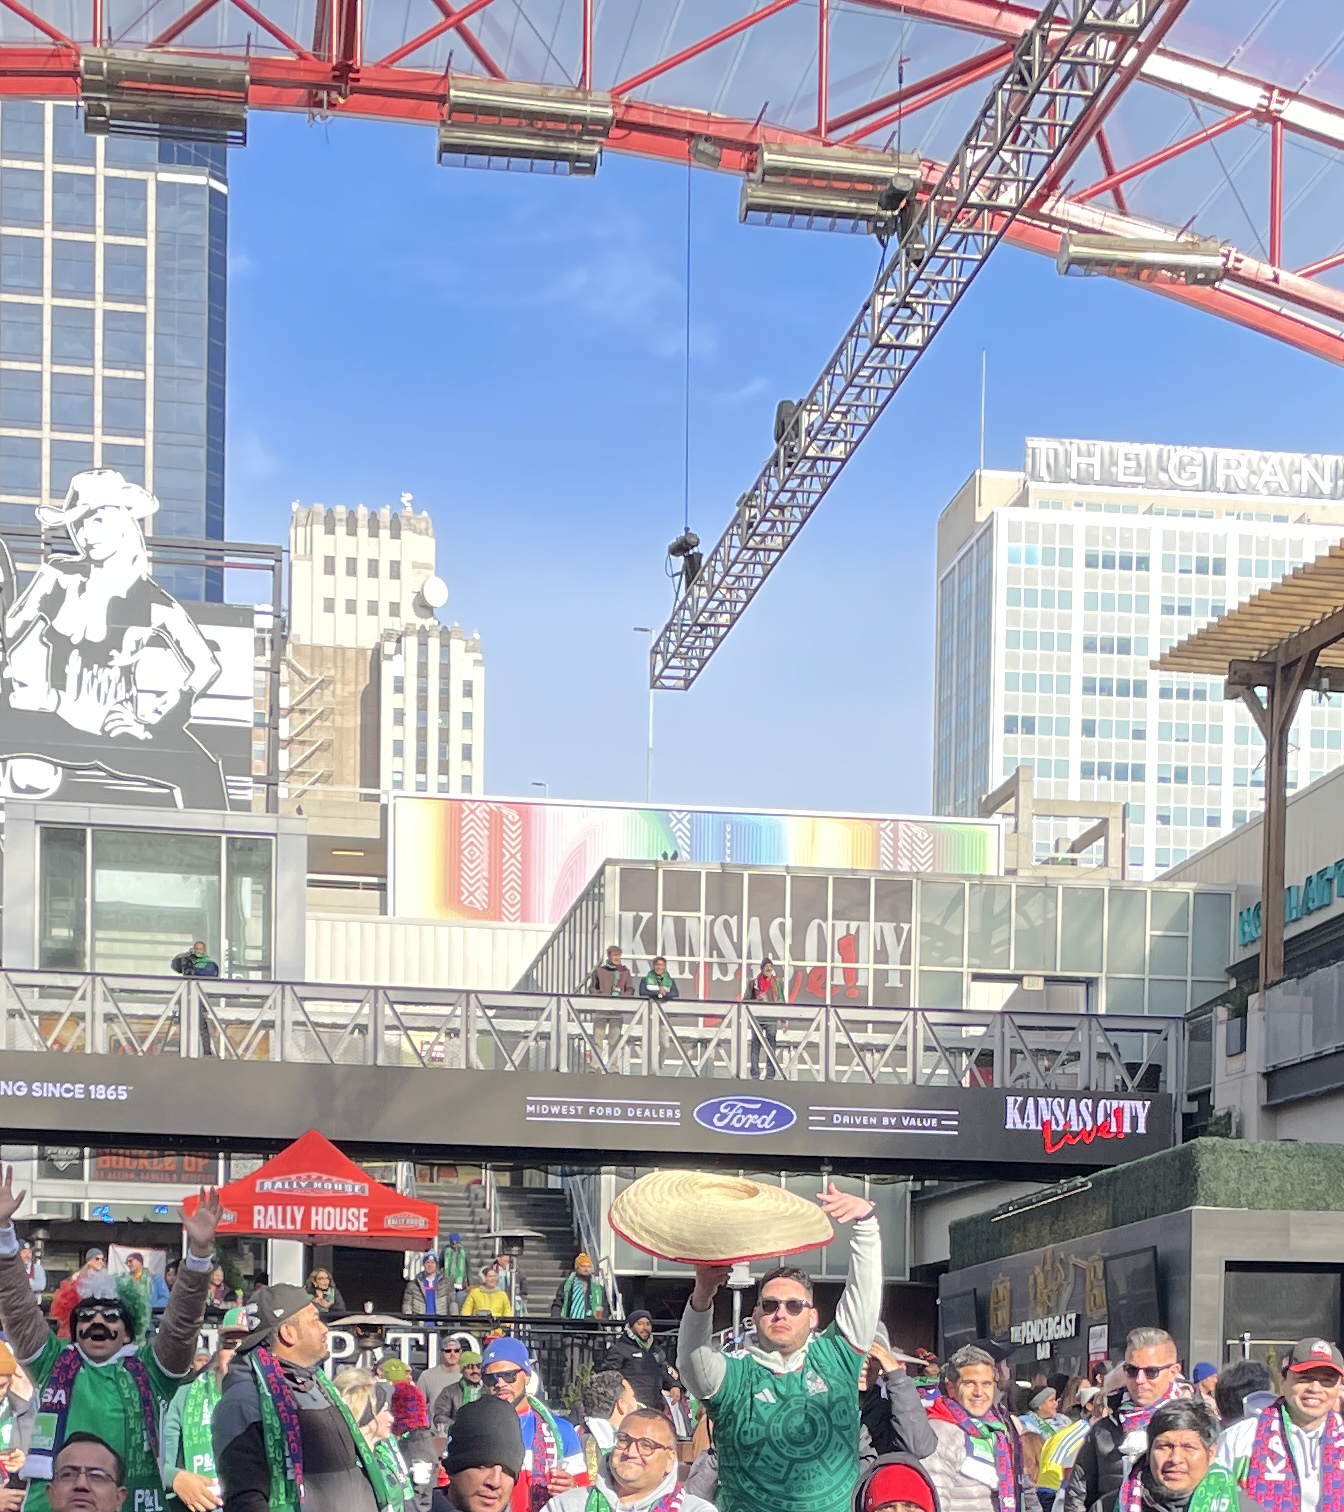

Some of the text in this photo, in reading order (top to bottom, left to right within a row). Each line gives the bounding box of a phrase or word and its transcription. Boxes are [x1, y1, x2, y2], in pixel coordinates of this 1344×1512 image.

[1036, 442, 1147, 486] THE
[619, 911, 912, 988] KANSAS CITY
[31, 1081, 85, 1099] SINCE
[89, 1084, 128, 1100] 1865
[526, 1104, 681, 1119] MIDWEST FORD DEALERS
[712, 1100, 776, 1130] Ford
[1005, 1096, 1151, 1134] KANSAS CITY
[1042, 1106, 1125, 1154] Live!
[263, 1180, 362, 1193] RALLY HOUSE
[253, 1205, 304, 1230] RALLY
[311, 1207, 368, 1232] HOUSE
[1021, 1312, 1077, 1345] PENDERGAST
[134, 1488, 164, 1512] P&L
